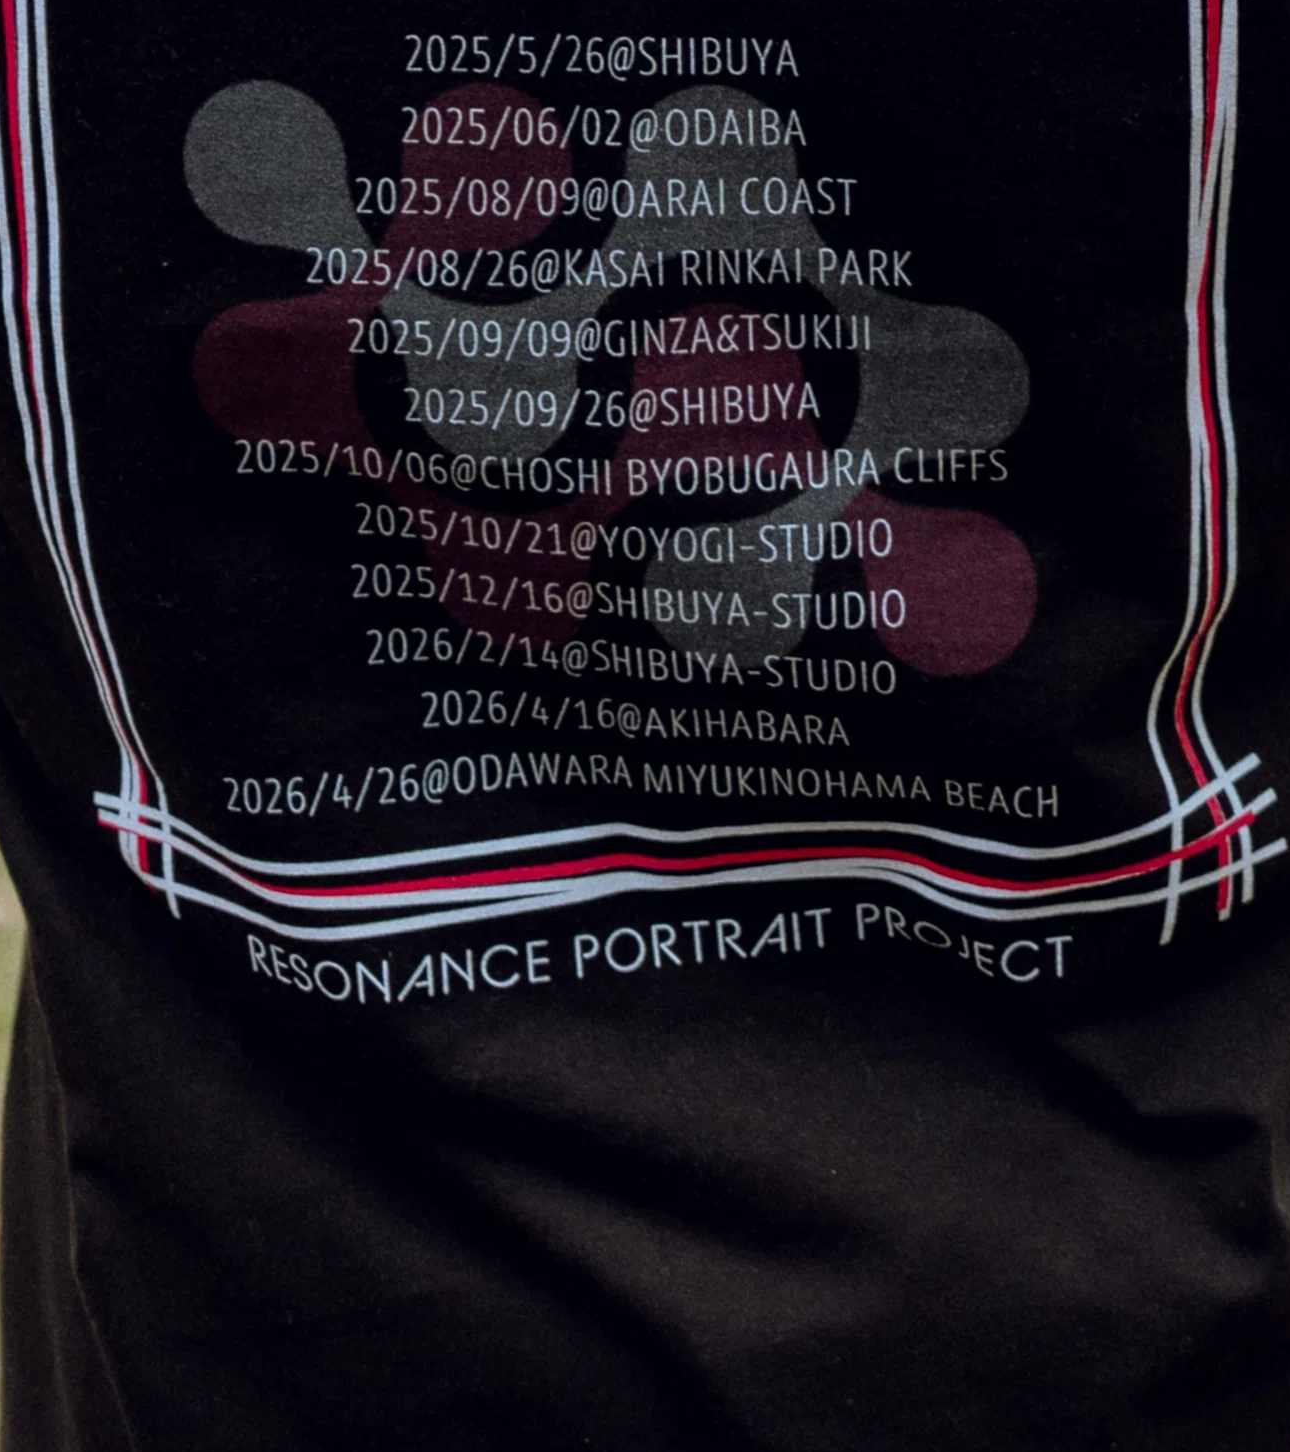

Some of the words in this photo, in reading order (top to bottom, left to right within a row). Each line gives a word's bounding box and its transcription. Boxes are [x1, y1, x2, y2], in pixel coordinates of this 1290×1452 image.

[404, 32, 800, 83] 2025/5/26@SHIBUYA
[355, 175, 726, 222] 2025/08/09@OARAI
[739, 175, 859, 217] COAST
[305, 246, 665, 294] 2025/08/26@KASAI
[680, 247, 802, 287] RINKAI
[817, 246, 913, 288] PARK
[346, 312, 872, 363] 2025/09/09@GINZA&TSUKIJI
[403, 380, 821, 434] 2025/09/26@SHIBUYA
[234, 437, 613, 497] 2025/10/06@CHOSHI
[626, 447, 881, 497] BYOBUGAURA
[893, 446, 1009, 485] CLIFFS
[355, 501, 894, 565] 2025/10/21@YOYOGI-STUDIO
[350, 563, 907, 631] 2025/12/16@SHIBUYA-STUDIO
[365, 628, 899, 697] 2026/2/14@SHIBUYA-STUDIO
[420, 689, 851, 747] 2026/4/16@AKIHABARA
[222, 751, 634, 818] 2026/4/26@ODAWARA
[642, 762, 932, 802] MIYUKINOHAMA
[944, 778, 1059, 819] BEACH
[246, 932, 552, 1005] RESONANCE
[573, 906, 833, 980] PORTRAIT
[854, 901, 1075, 983] PROJECT
